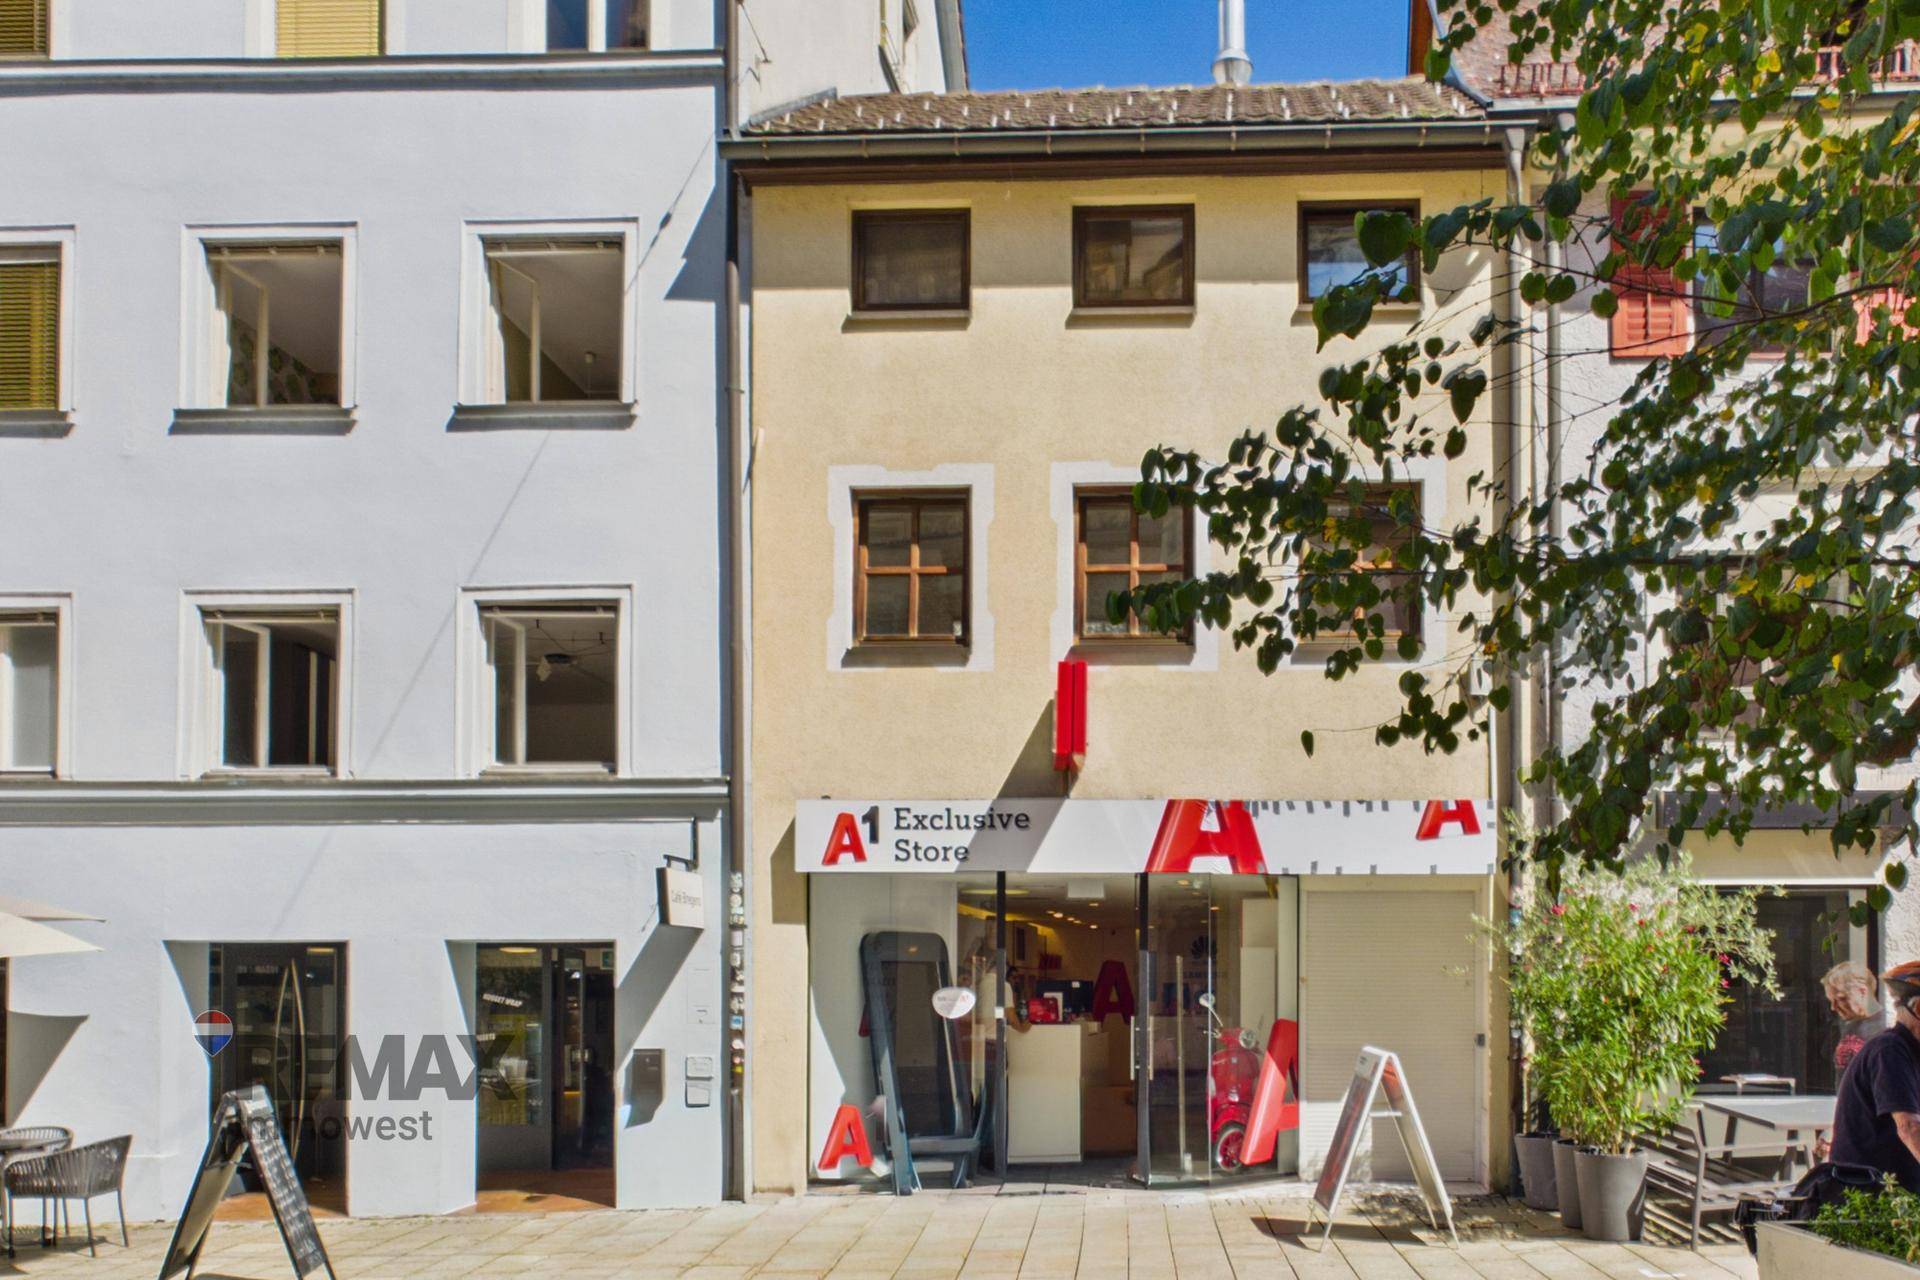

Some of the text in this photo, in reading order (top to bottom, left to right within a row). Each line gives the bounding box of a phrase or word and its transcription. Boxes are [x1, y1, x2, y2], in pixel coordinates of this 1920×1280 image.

[821, 805, 880, 866] A1
[894, 807, 1030, 831] Exclusive
[894, 838, 970, 863] Store
[817, 1103, 874, 1171] A
